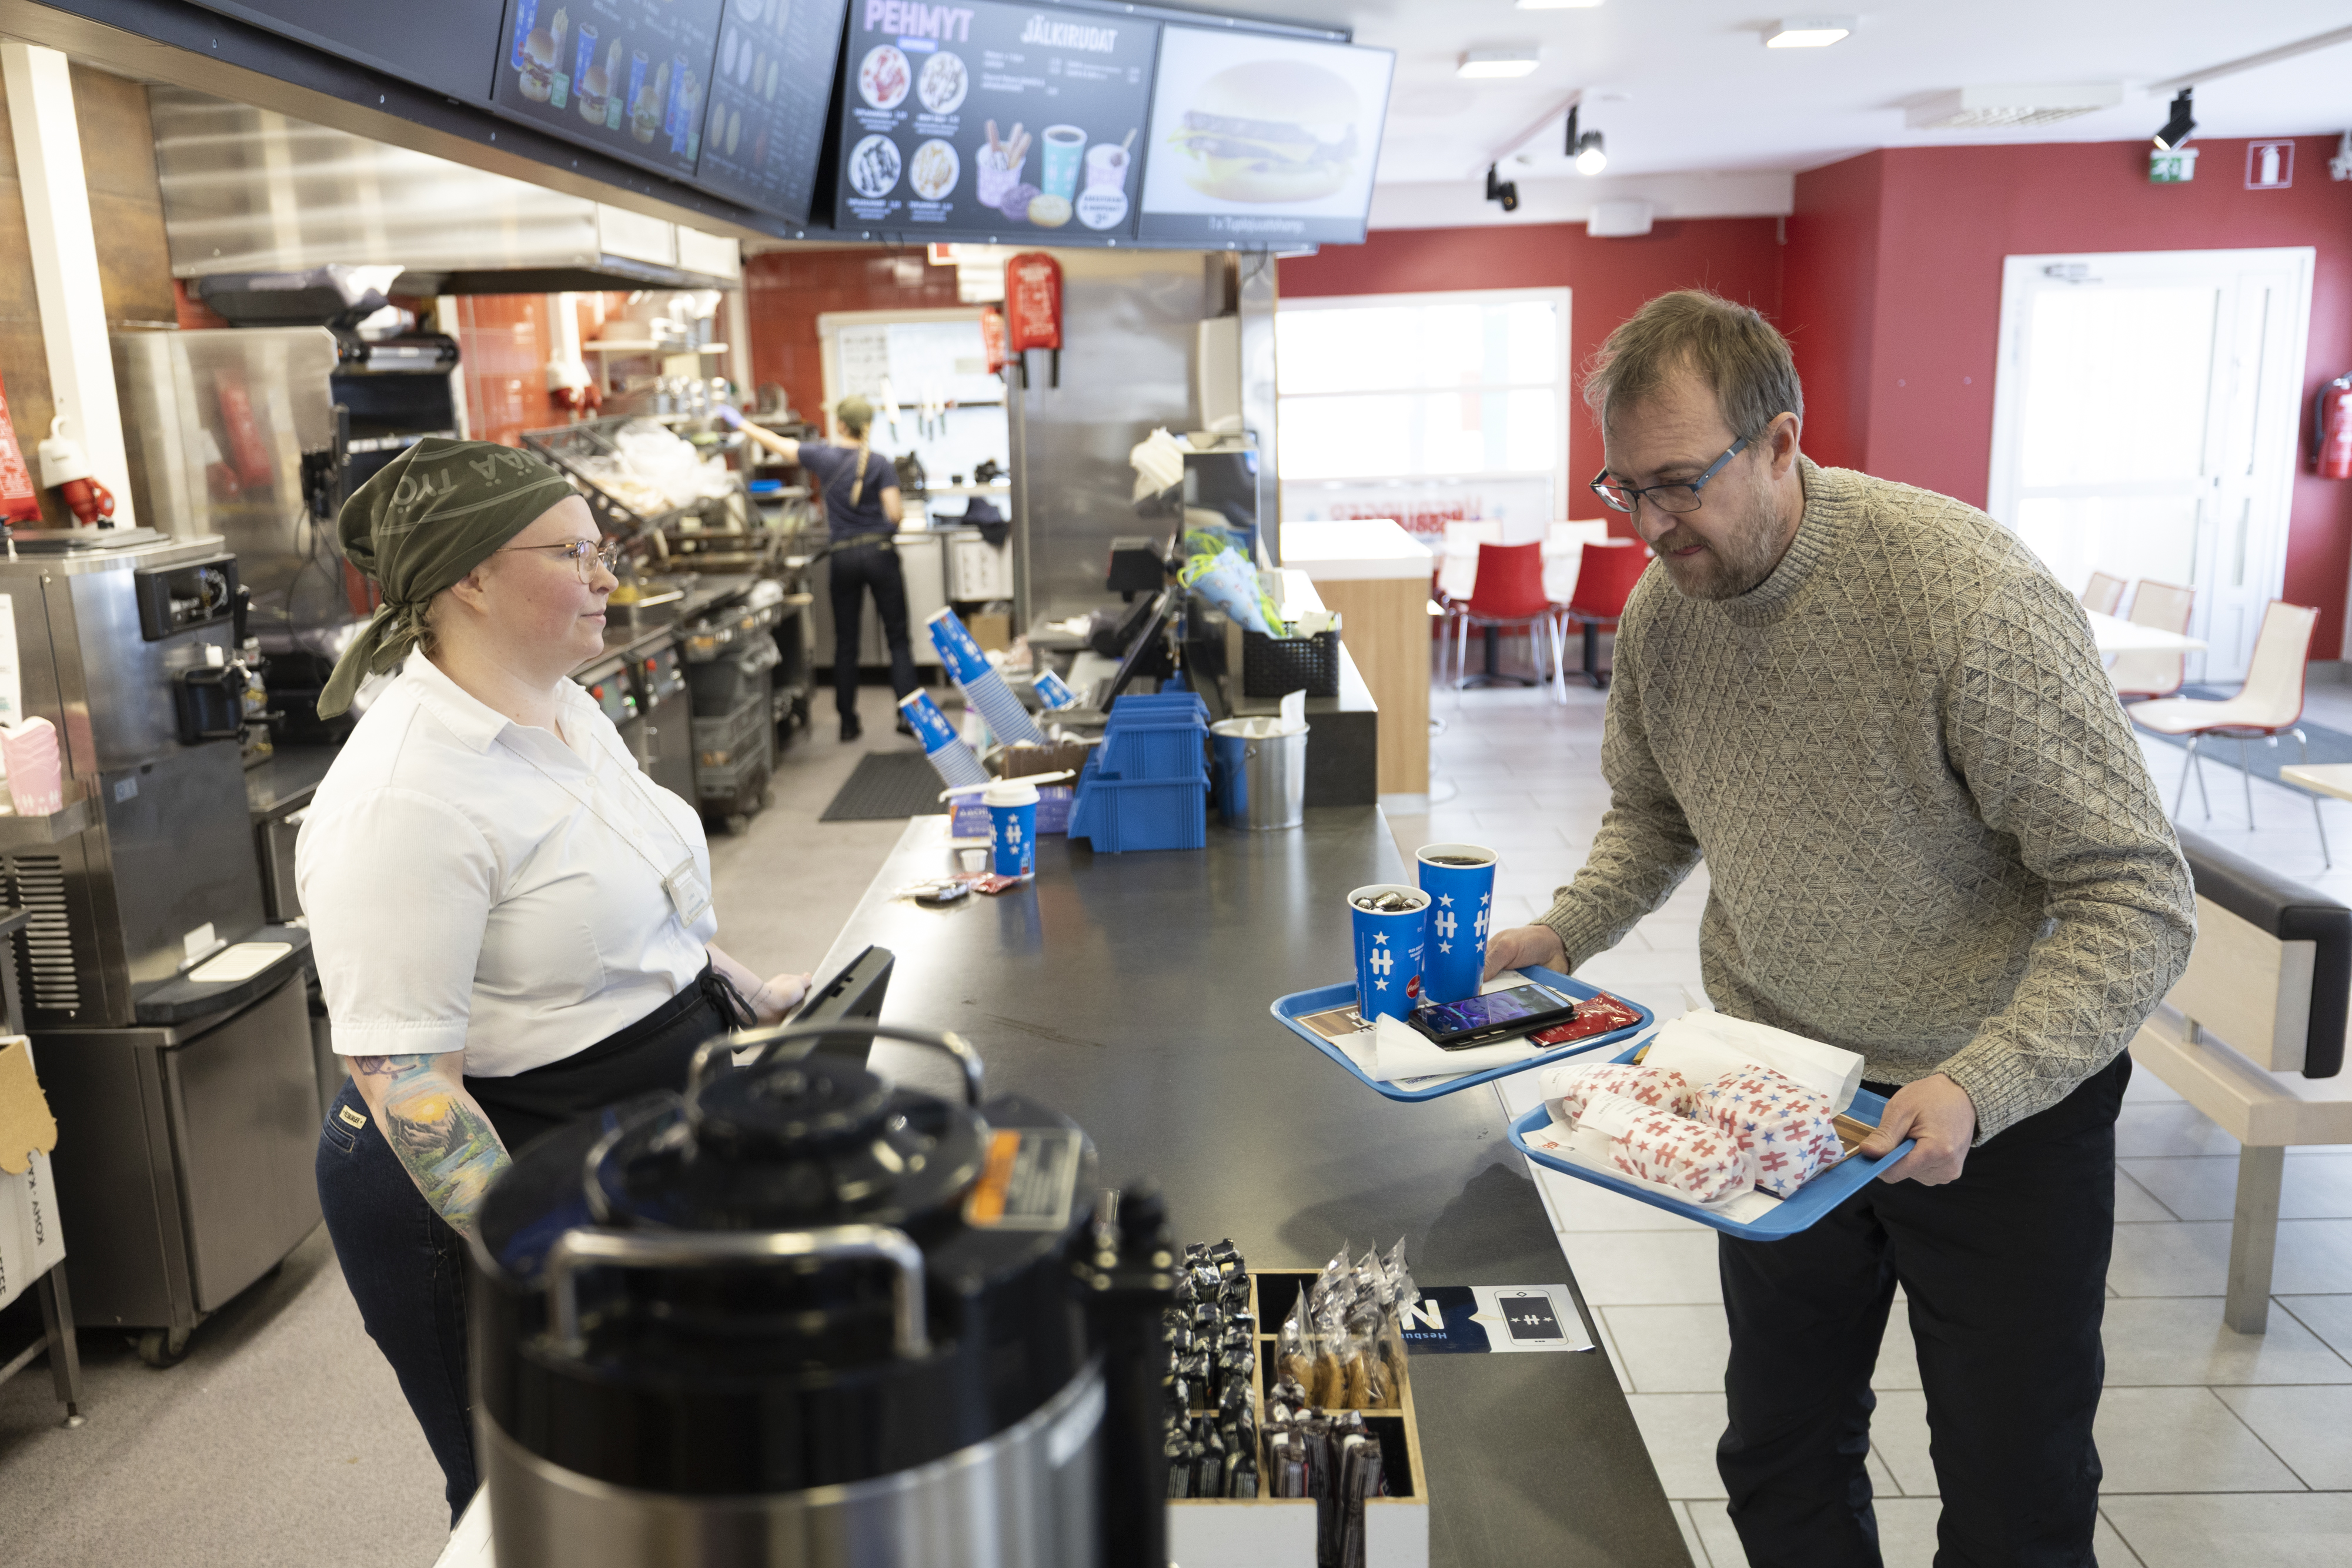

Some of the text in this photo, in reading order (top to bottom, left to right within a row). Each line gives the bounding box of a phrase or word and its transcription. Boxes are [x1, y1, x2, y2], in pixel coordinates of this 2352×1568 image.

[863, 0, 974, 43] PEHMYT
[1435, 910, 1458, 938] H
[1474, 909, 1489, 935] H
[1369, 948, 1394, 975] H
